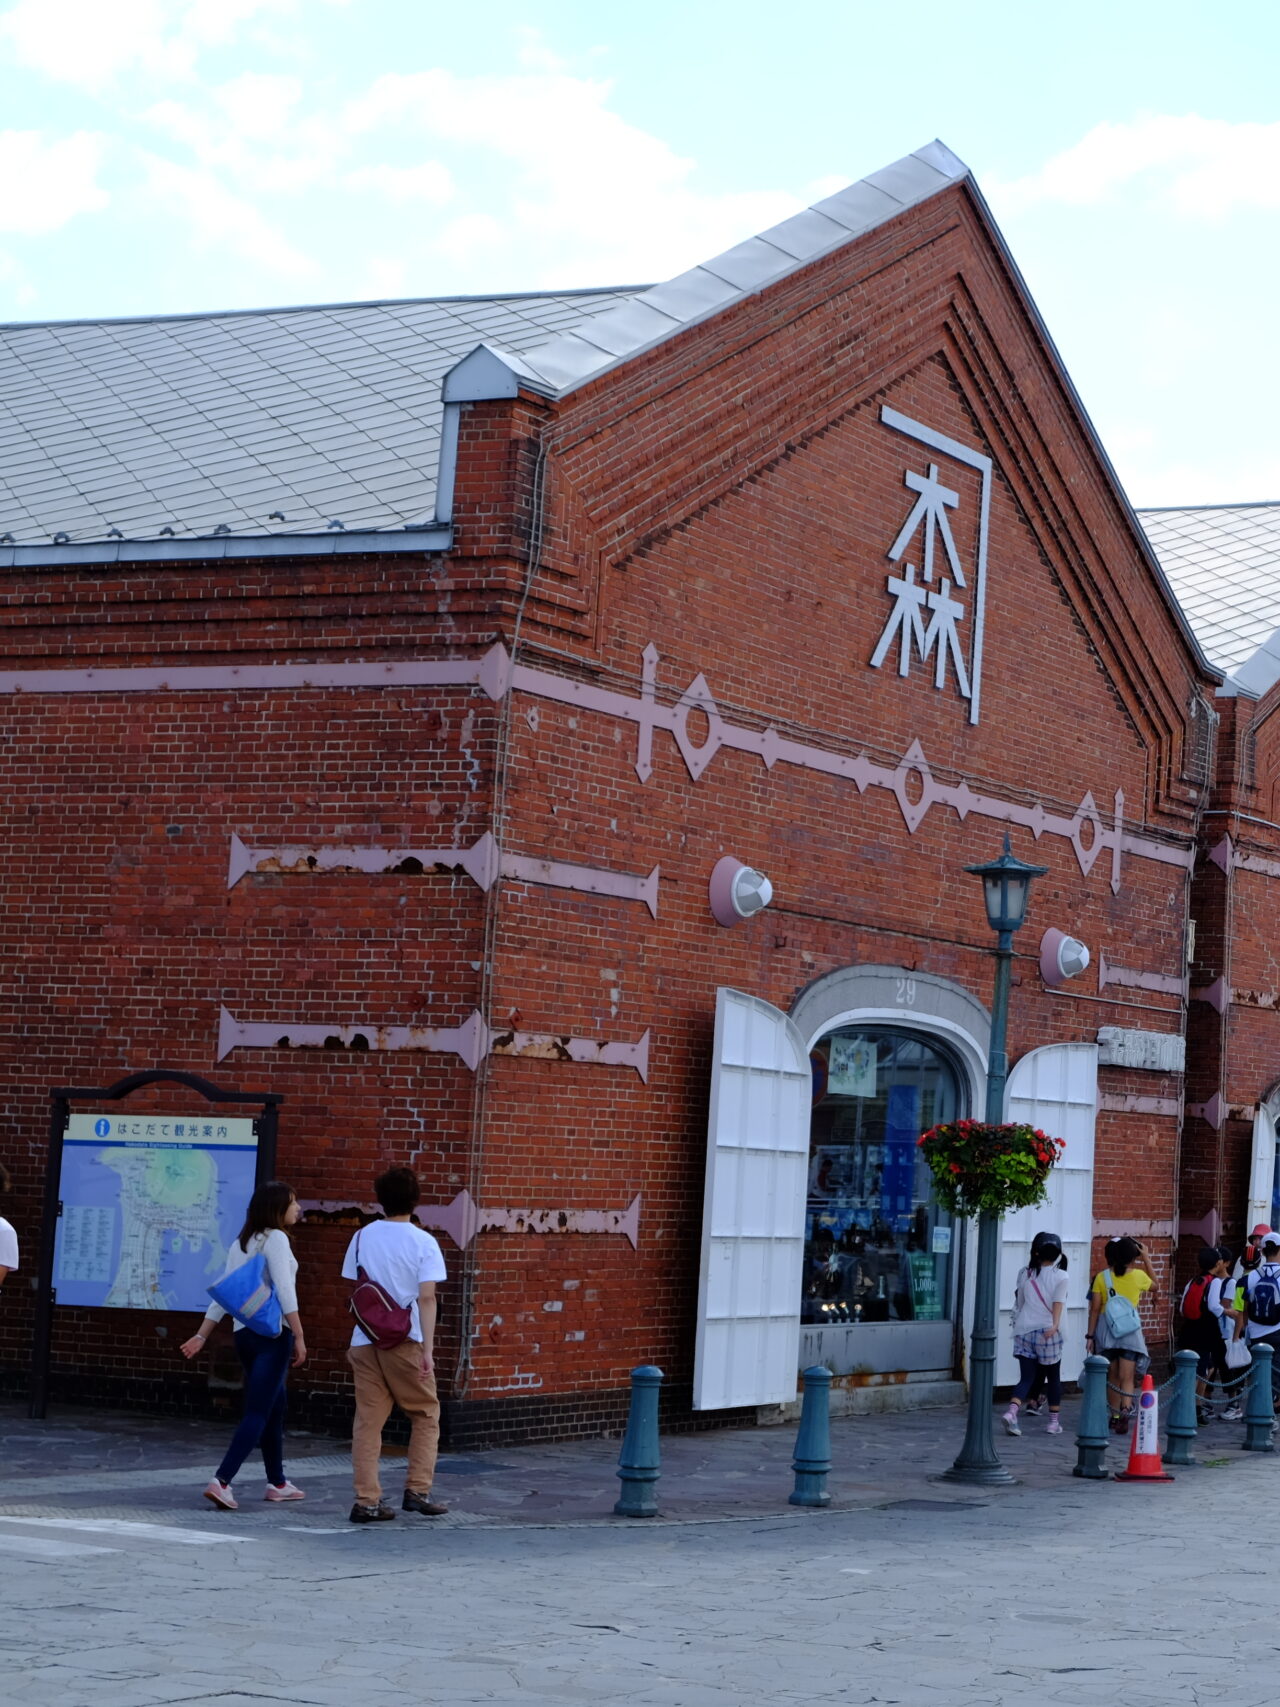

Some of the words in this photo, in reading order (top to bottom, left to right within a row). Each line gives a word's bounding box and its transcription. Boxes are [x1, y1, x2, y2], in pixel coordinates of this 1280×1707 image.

[896, 977, 916, 1005] 29
[117, 1122, 228, 1138] はこだて観光案内
